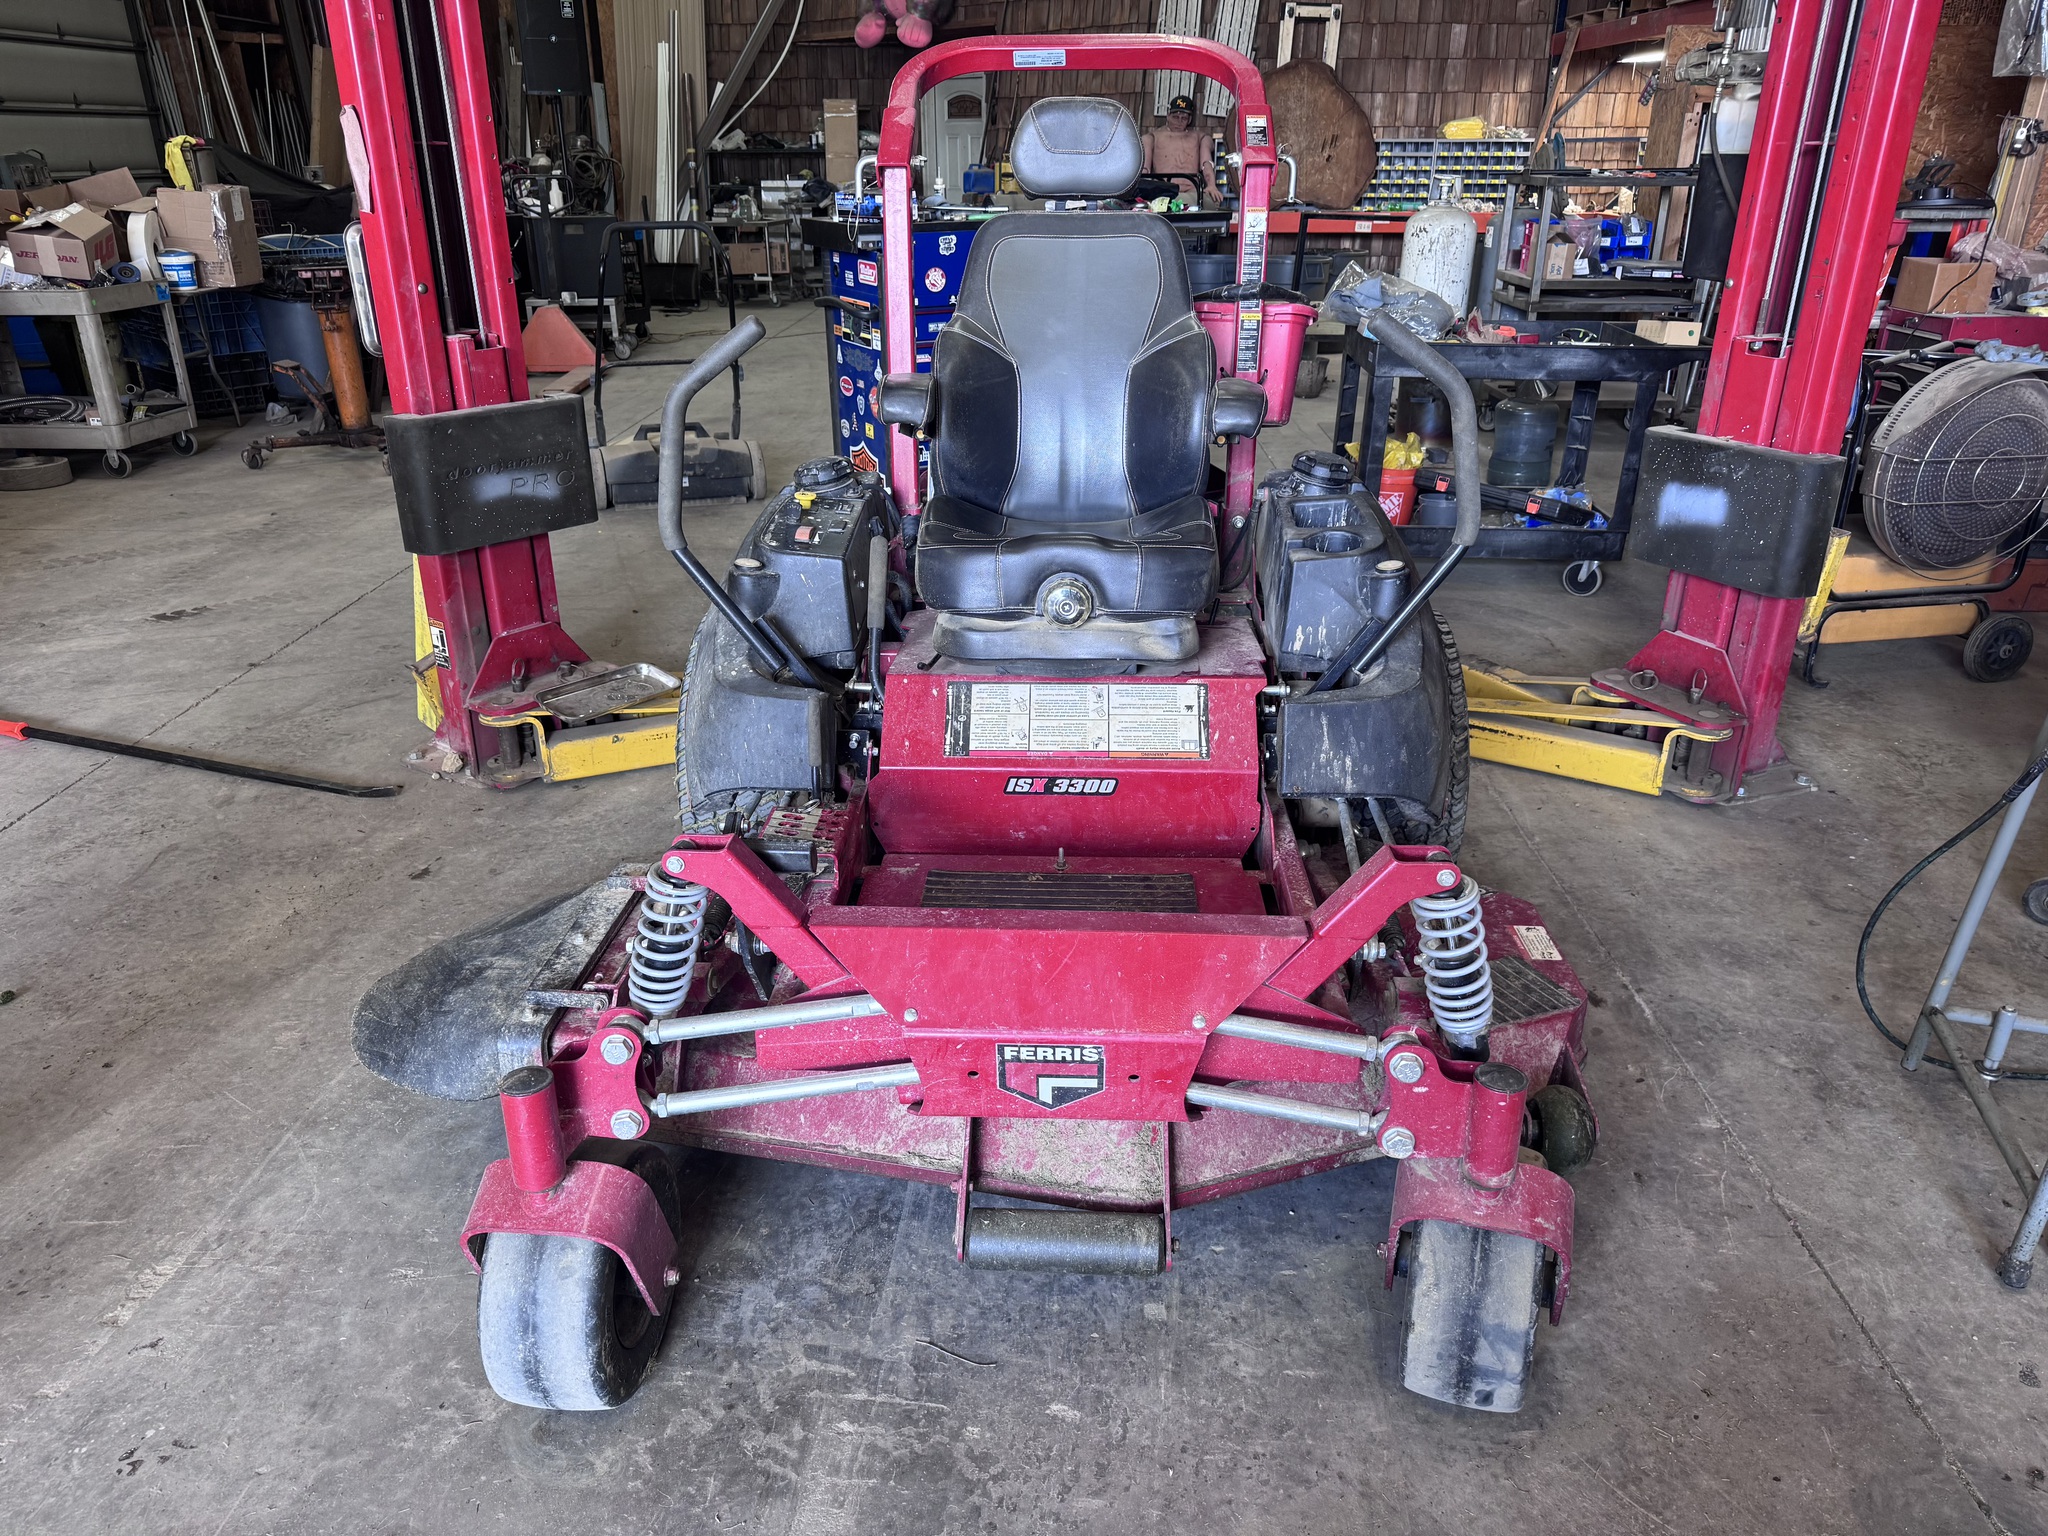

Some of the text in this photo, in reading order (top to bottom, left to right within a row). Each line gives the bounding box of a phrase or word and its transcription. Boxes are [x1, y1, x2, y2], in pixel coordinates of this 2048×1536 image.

[447, 449, 574, 480] doorjammer
[510, 470, 576, 496] PRO
[1006, 778, 1118, 794] ISX 3300
[1004, 1046, 1099, 1061] FERRIS
